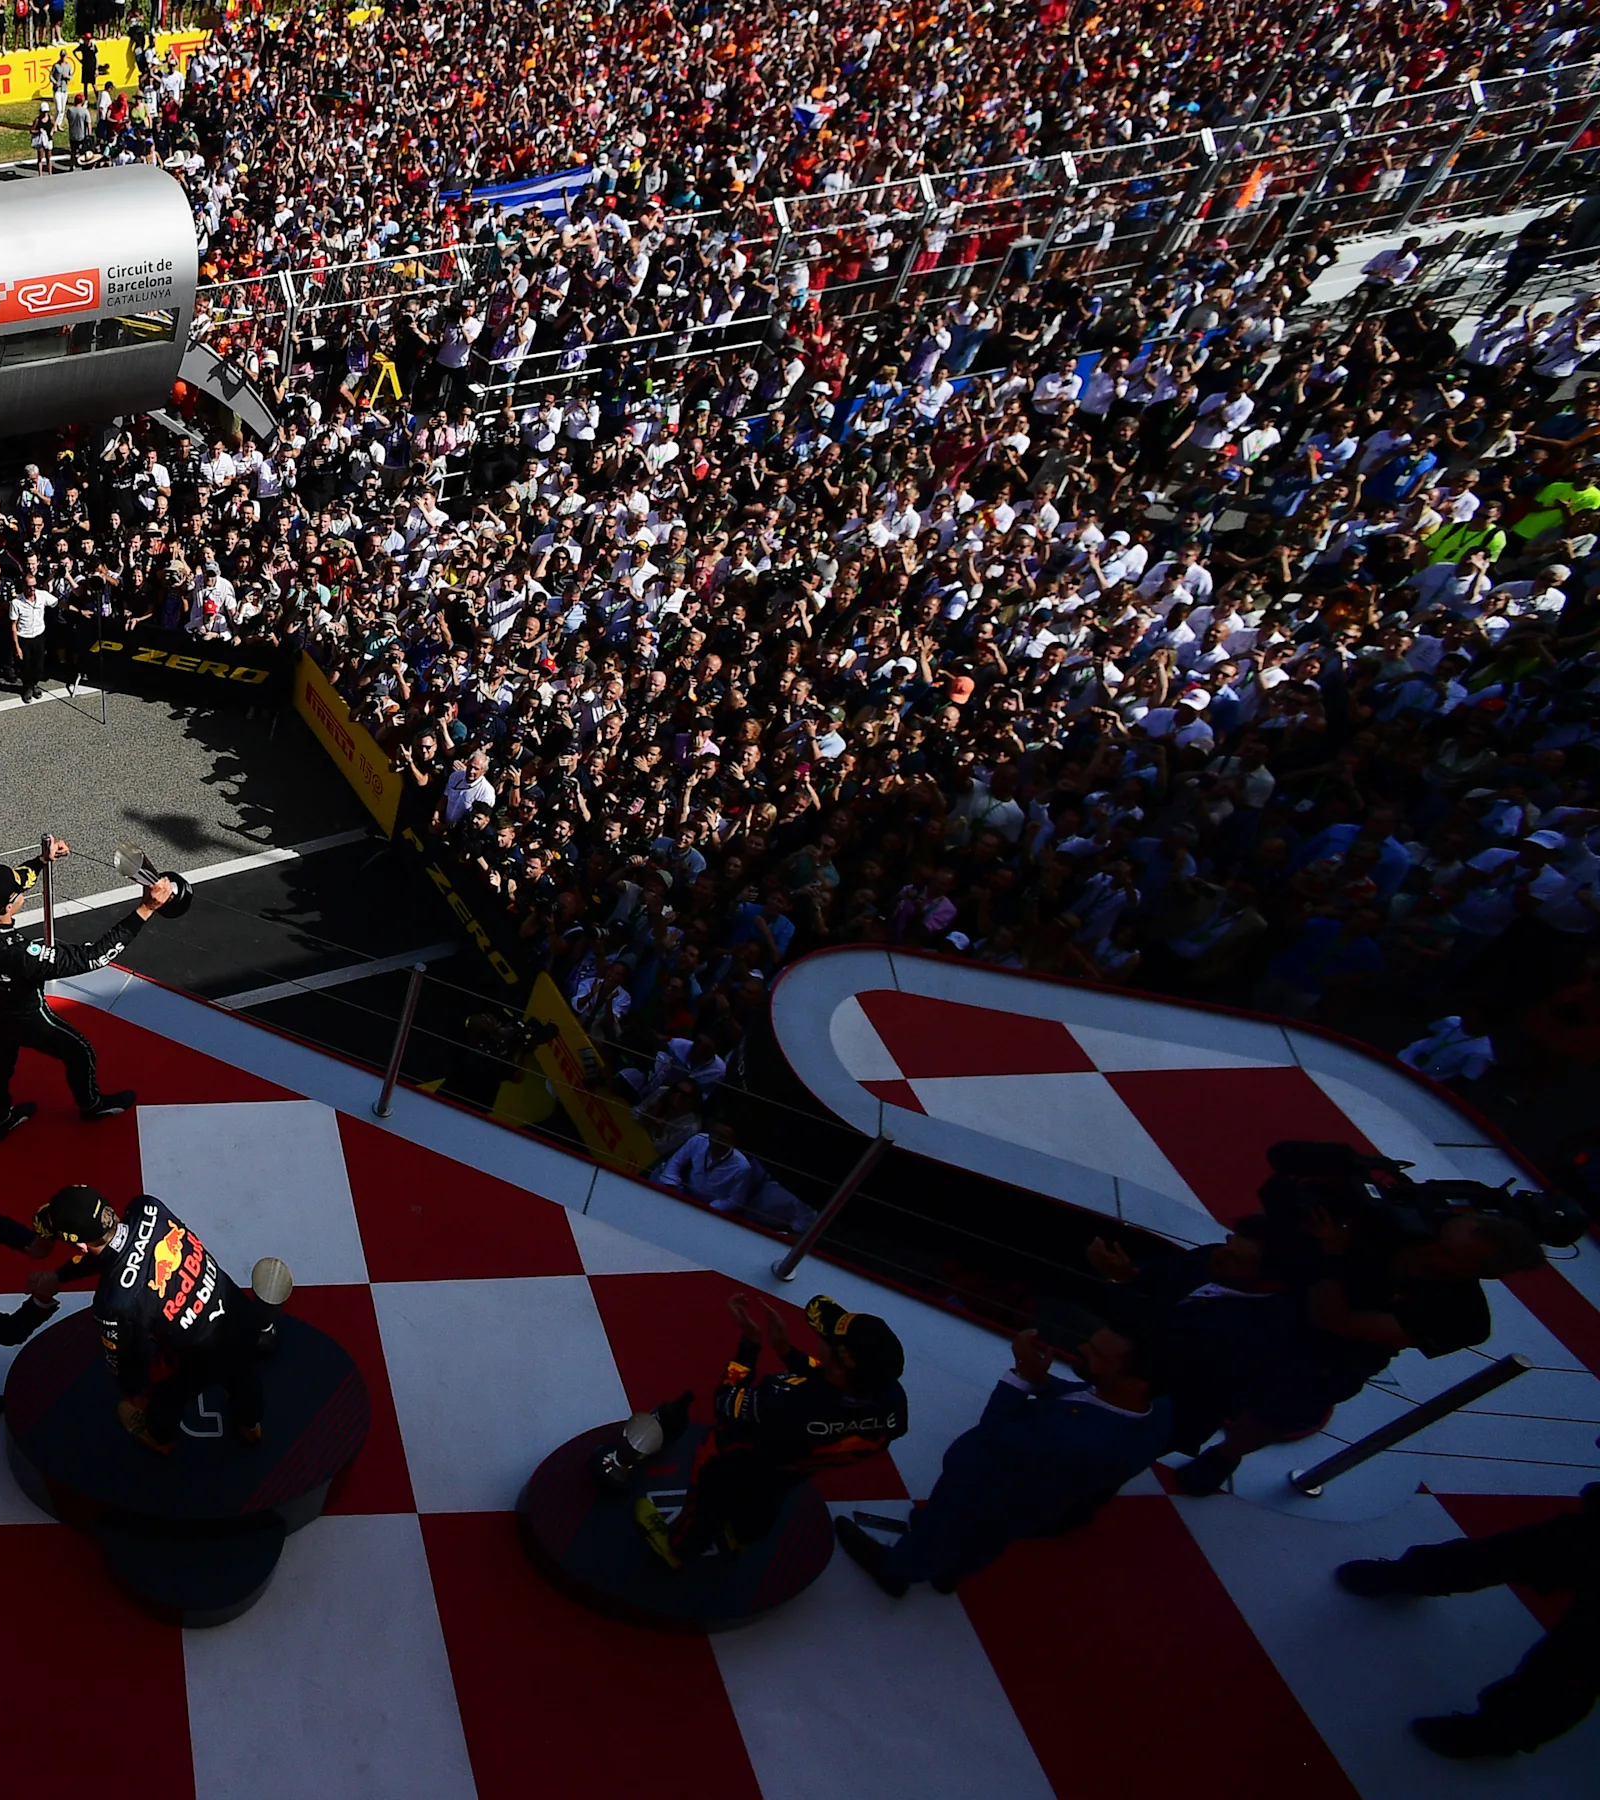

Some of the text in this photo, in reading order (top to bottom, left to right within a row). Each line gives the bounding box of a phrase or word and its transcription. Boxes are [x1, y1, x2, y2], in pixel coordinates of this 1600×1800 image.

[107, 258, 173, 279] Circuit de
[107, 275, 173, 294] Barcelona
[106, 288, 172, 307] CATALUNYA
[89, 640, 270, 684] P ZERO
[305, 681, 356, 763] PIRELLI
[426, 862, 519, 985] ZERO
[89, 941, 125, 970] INEOS
[120, 1204, 158, 1288] ORACLE
[163, 1231, 204, 1321] Red Bull
[180, 1273, 216, 1330] Mobil
[806, 1412, 897, 1435] ORACLE
